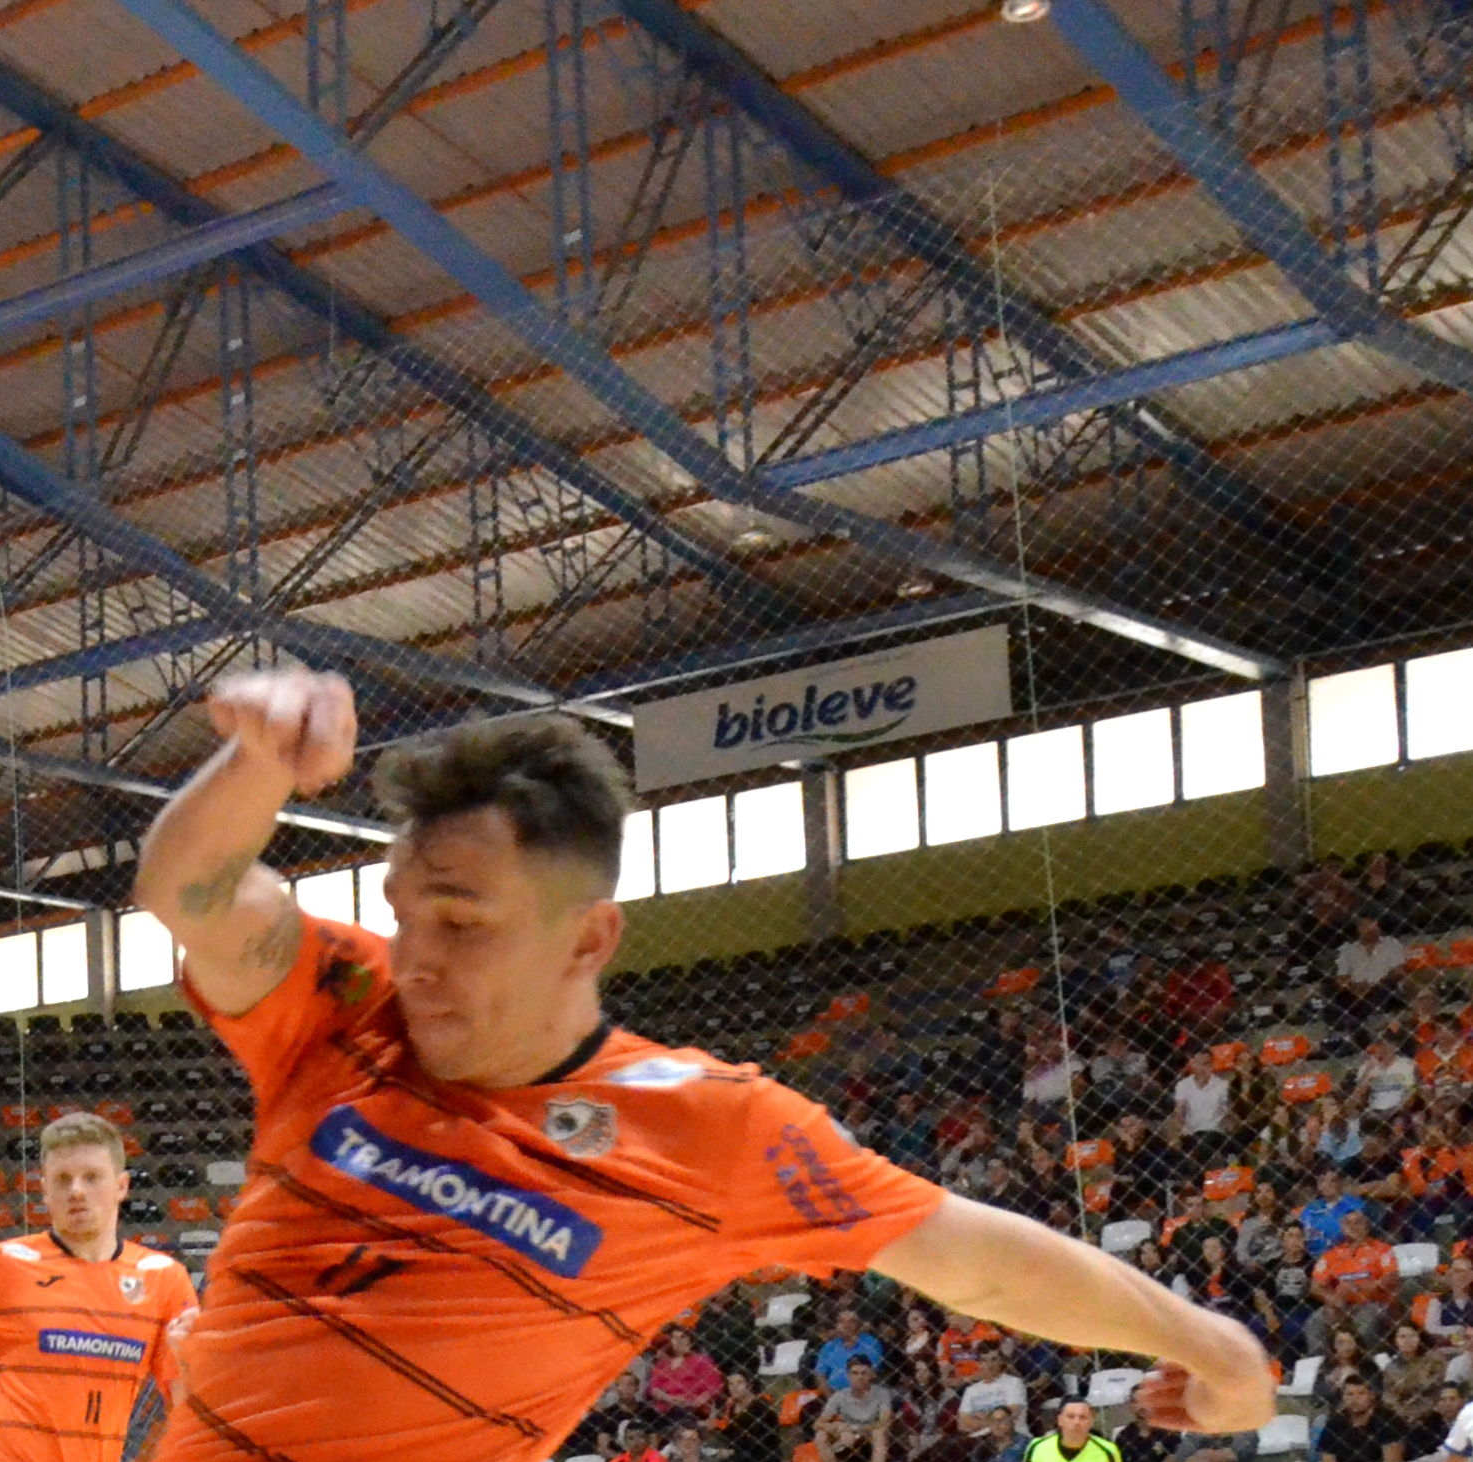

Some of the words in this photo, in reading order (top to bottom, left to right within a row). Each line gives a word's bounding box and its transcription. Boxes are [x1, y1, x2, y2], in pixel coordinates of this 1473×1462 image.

[713, 675, 917, 749] bioleve
[335, 1126, 573, 1261] TRAMONTINA
[46, 1334, 143, 1362] TRAMONTINA
